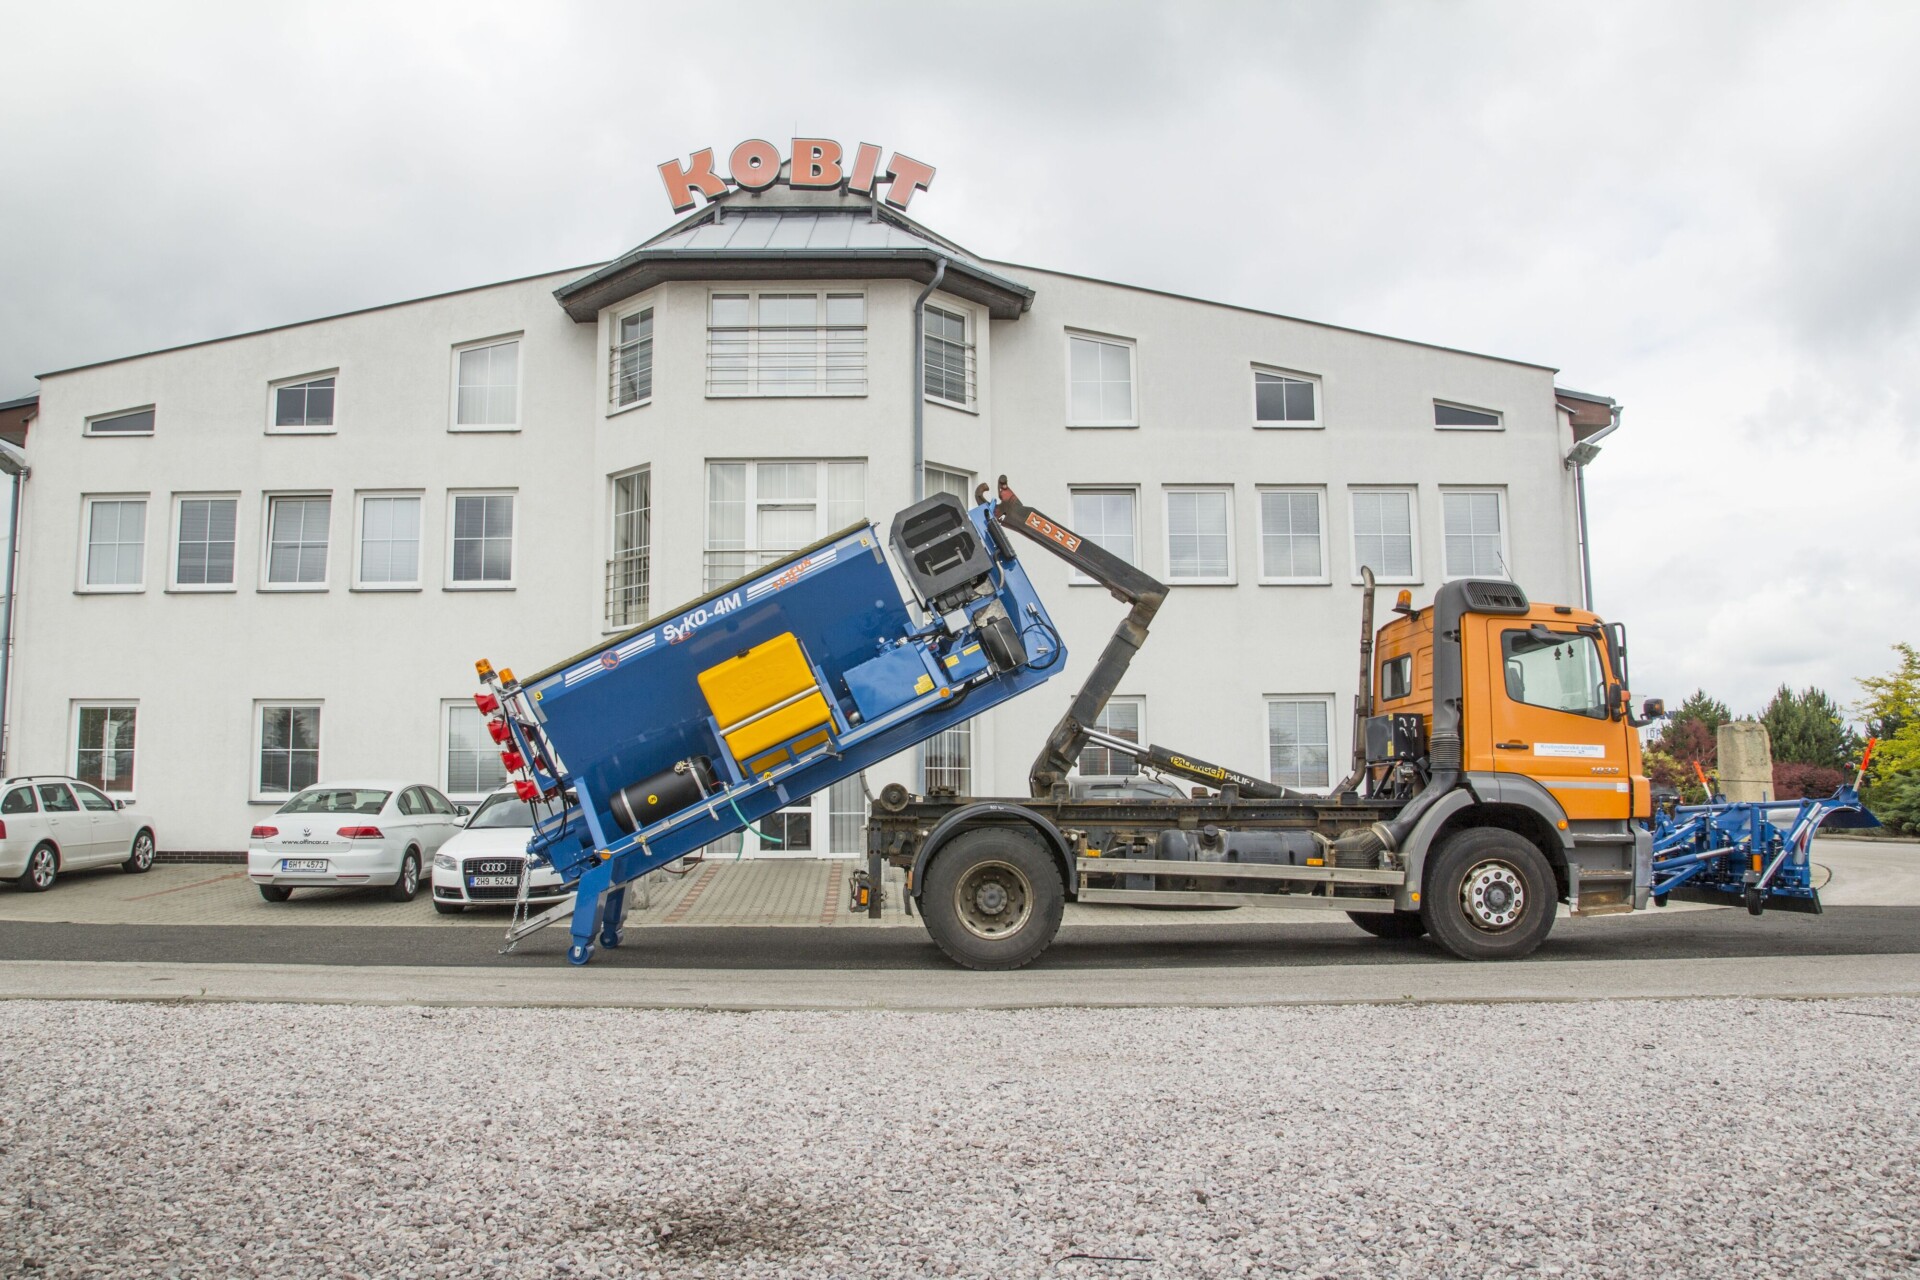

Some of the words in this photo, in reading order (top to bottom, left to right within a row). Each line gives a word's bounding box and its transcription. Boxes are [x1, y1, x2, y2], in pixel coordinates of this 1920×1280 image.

[657, 137, 937, 215] KOBIT
[1030, 516, 1077, 549] KUHN
[288, 860, 301, 869] 6H1
[306, 860, 324, 869] 4573
[476, 877, 490, 885] 2H9
[495, 877, 514, 885] 5242
